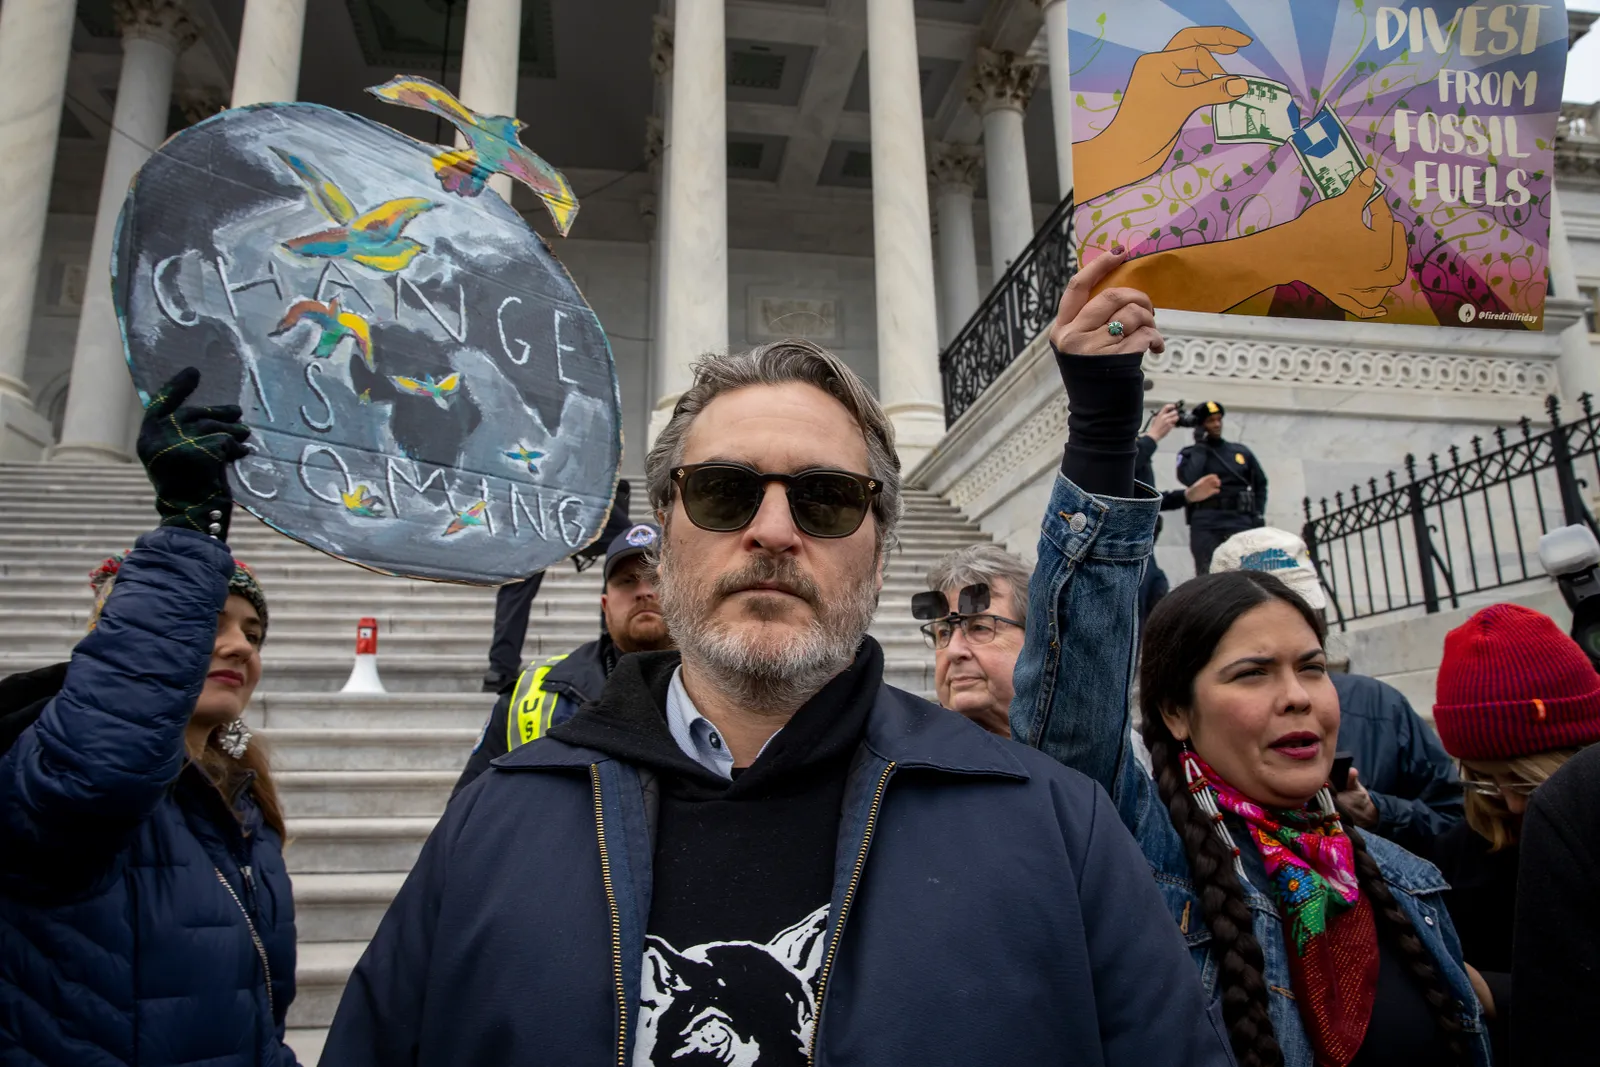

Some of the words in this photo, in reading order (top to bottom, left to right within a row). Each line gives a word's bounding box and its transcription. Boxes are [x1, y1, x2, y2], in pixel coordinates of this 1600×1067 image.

[1376, 4, 1552, 56] DIVEST
[1438, 69, 1538, 107] FROM
[1394, 109, 1531, 158] FOSSIL
[1414, 161, 1531, 206] FUELS
[153, 250, 580, 386] CHANGE
[1478, 311, 1538, 323] @firedrillfriday
[241, 340, 335, 433] IS
[232, 442, 585, 548] COMING
